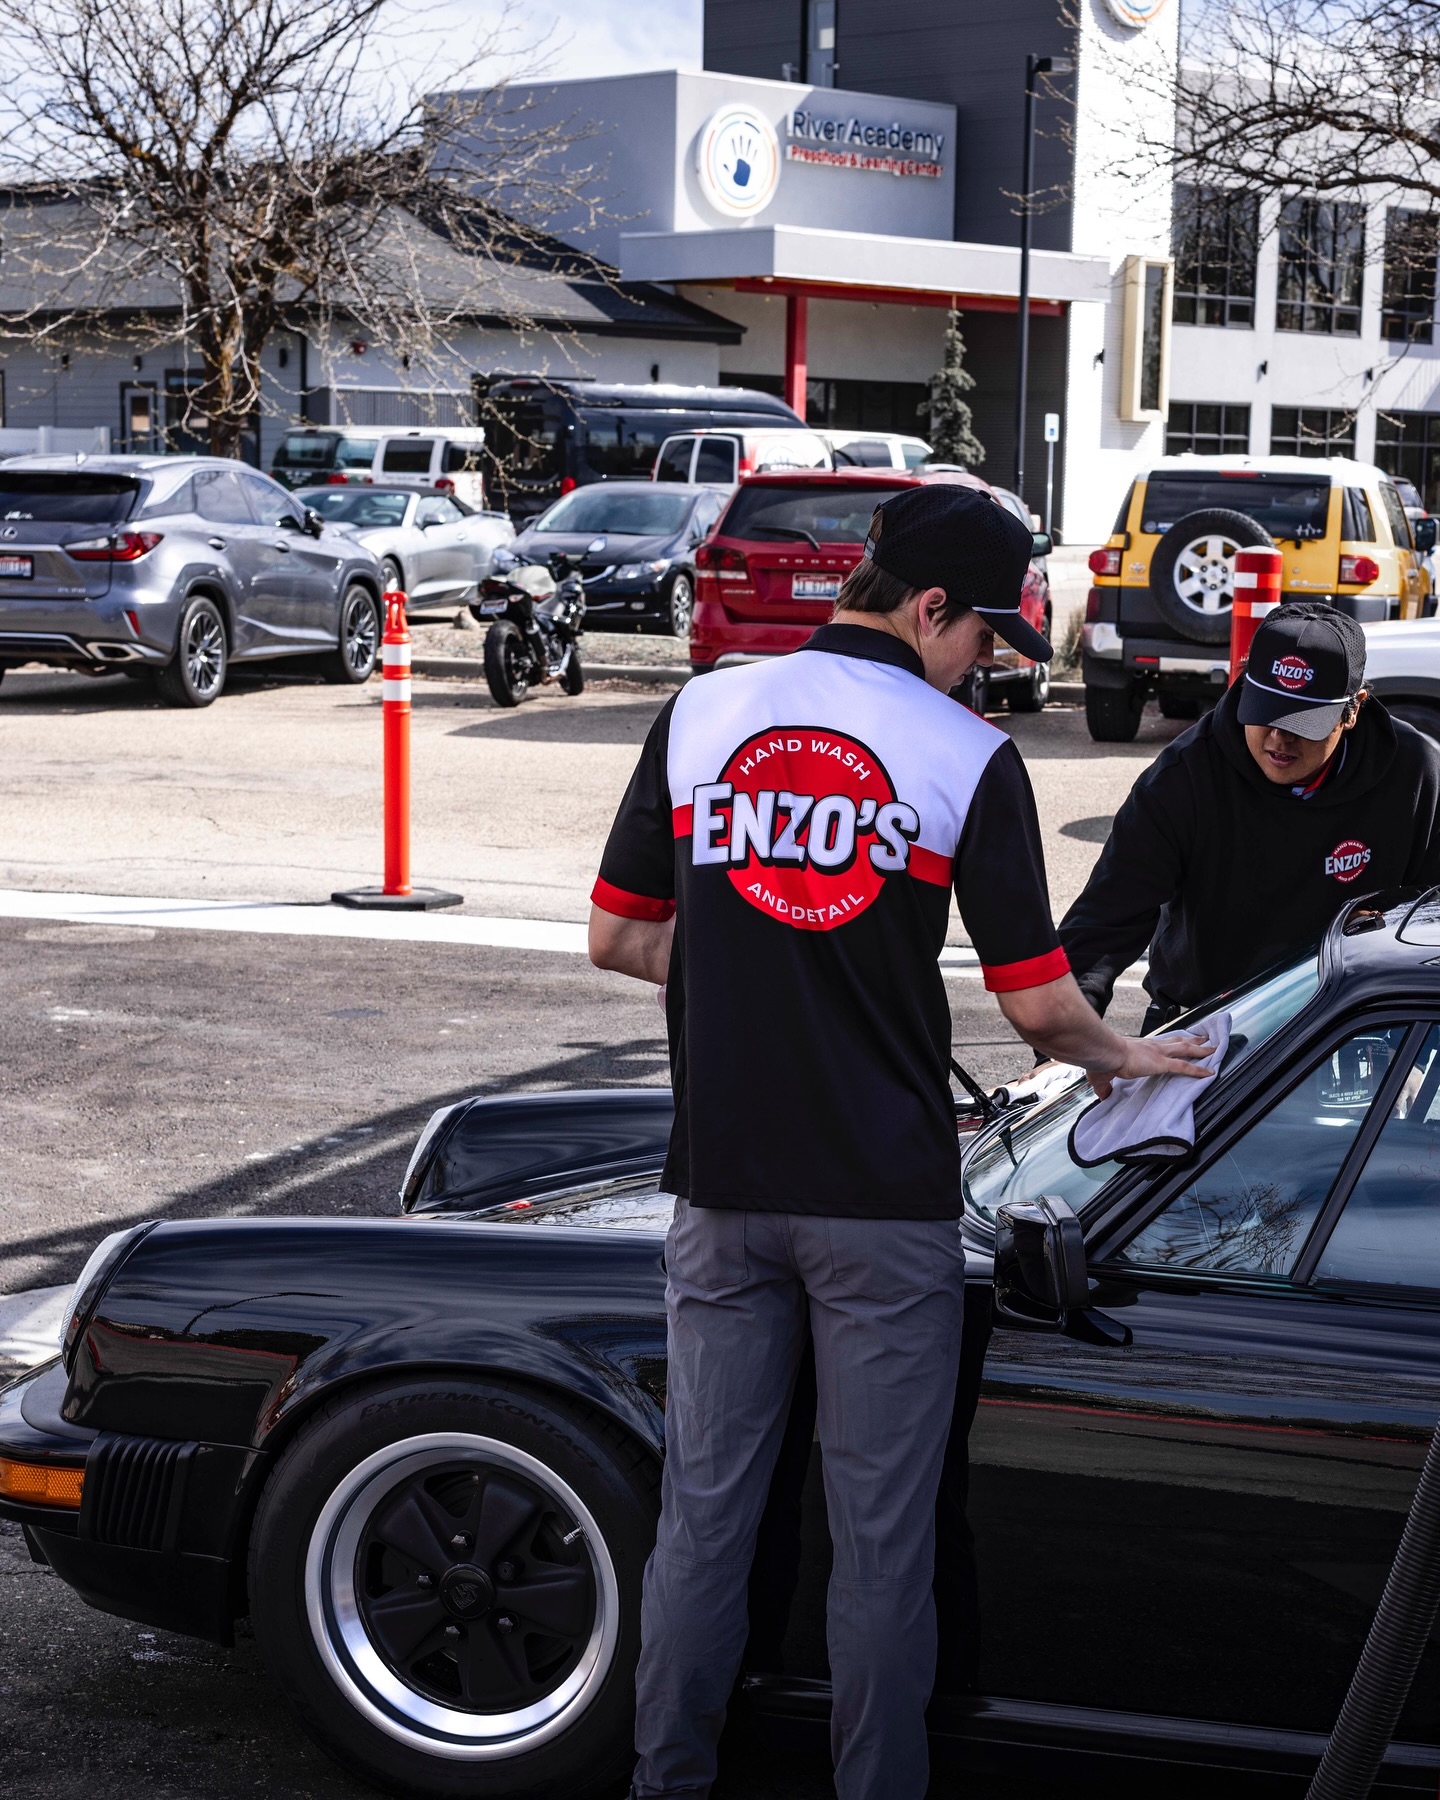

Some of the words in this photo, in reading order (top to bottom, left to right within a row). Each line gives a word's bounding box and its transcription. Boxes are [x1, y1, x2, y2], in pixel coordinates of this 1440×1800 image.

[788, 111, 845, 141] River
[847, 118, 945, 160] Academy
[788, 144, 847, 167] Preschool
[860, 153, 905, 176] Learning
[906, 160, 944, 177] Center
[1271, 660, 1314, 681] ENZO'S
[738, 738, 803, 776] HAND
[811, 739, 871, 781] WASH
[692, 782, 920, 873] ENZO'S
[1325, 848, 1371, 875] ENZO'S
[1334, 842, 1348, 855] HAND
[746, 882, 788, 914] AND
[791, 893, 865, 923] DETAIL
